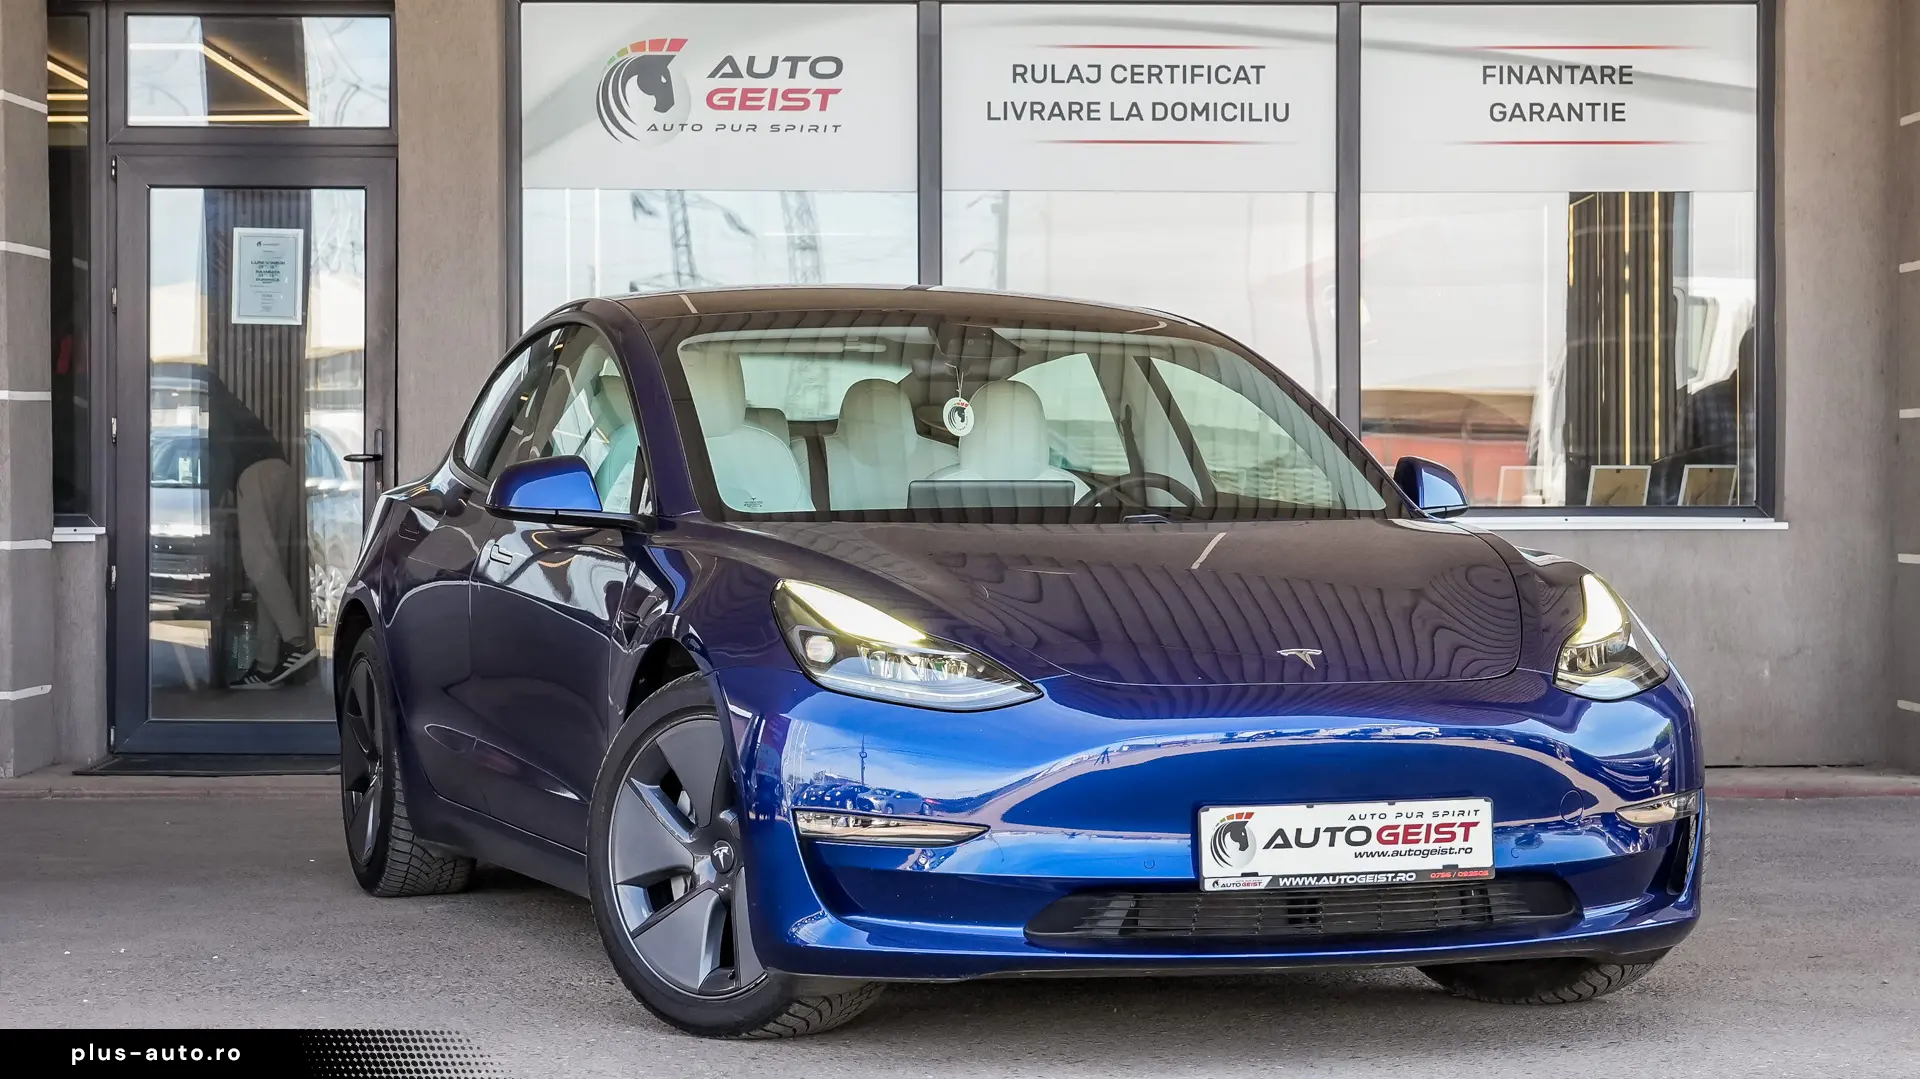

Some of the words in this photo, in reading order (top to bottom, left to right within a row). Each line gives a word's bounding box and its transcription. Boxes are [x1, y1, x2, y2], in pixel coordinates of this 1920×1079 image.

[706, 55, 844, 80] AUTO
[1012, 64, 1102, 85] RULAJ
[1110, 64, 1266, 85] CERTIFICAT
[1482, 64, 1634, 85] FINANTARE
[705, 87, 843, 112] GEIST
[986, 102, 1102, 122] LIVRARE
[1110, 102, 1144, 122] LA
[1151, 102, 1290, 122] DOMICILIU
[1489, 103, 1626, 122] GARANTIE
[646, 123, 704, 133] AUTO
[715, 123, 758, 133] PUR
[769, 123, 843, 133] SPIRIT
[1347, 812, 1387, 821] AUTO
[1395, 811, 1424, 819] PUR
[1432, 809, 1480, 818] SPIRIT
[1354, 846, 1474, 860] www.autogeist.ro
[1278, 872, 1417, 887] WWW.AUTOGEIST.RO
